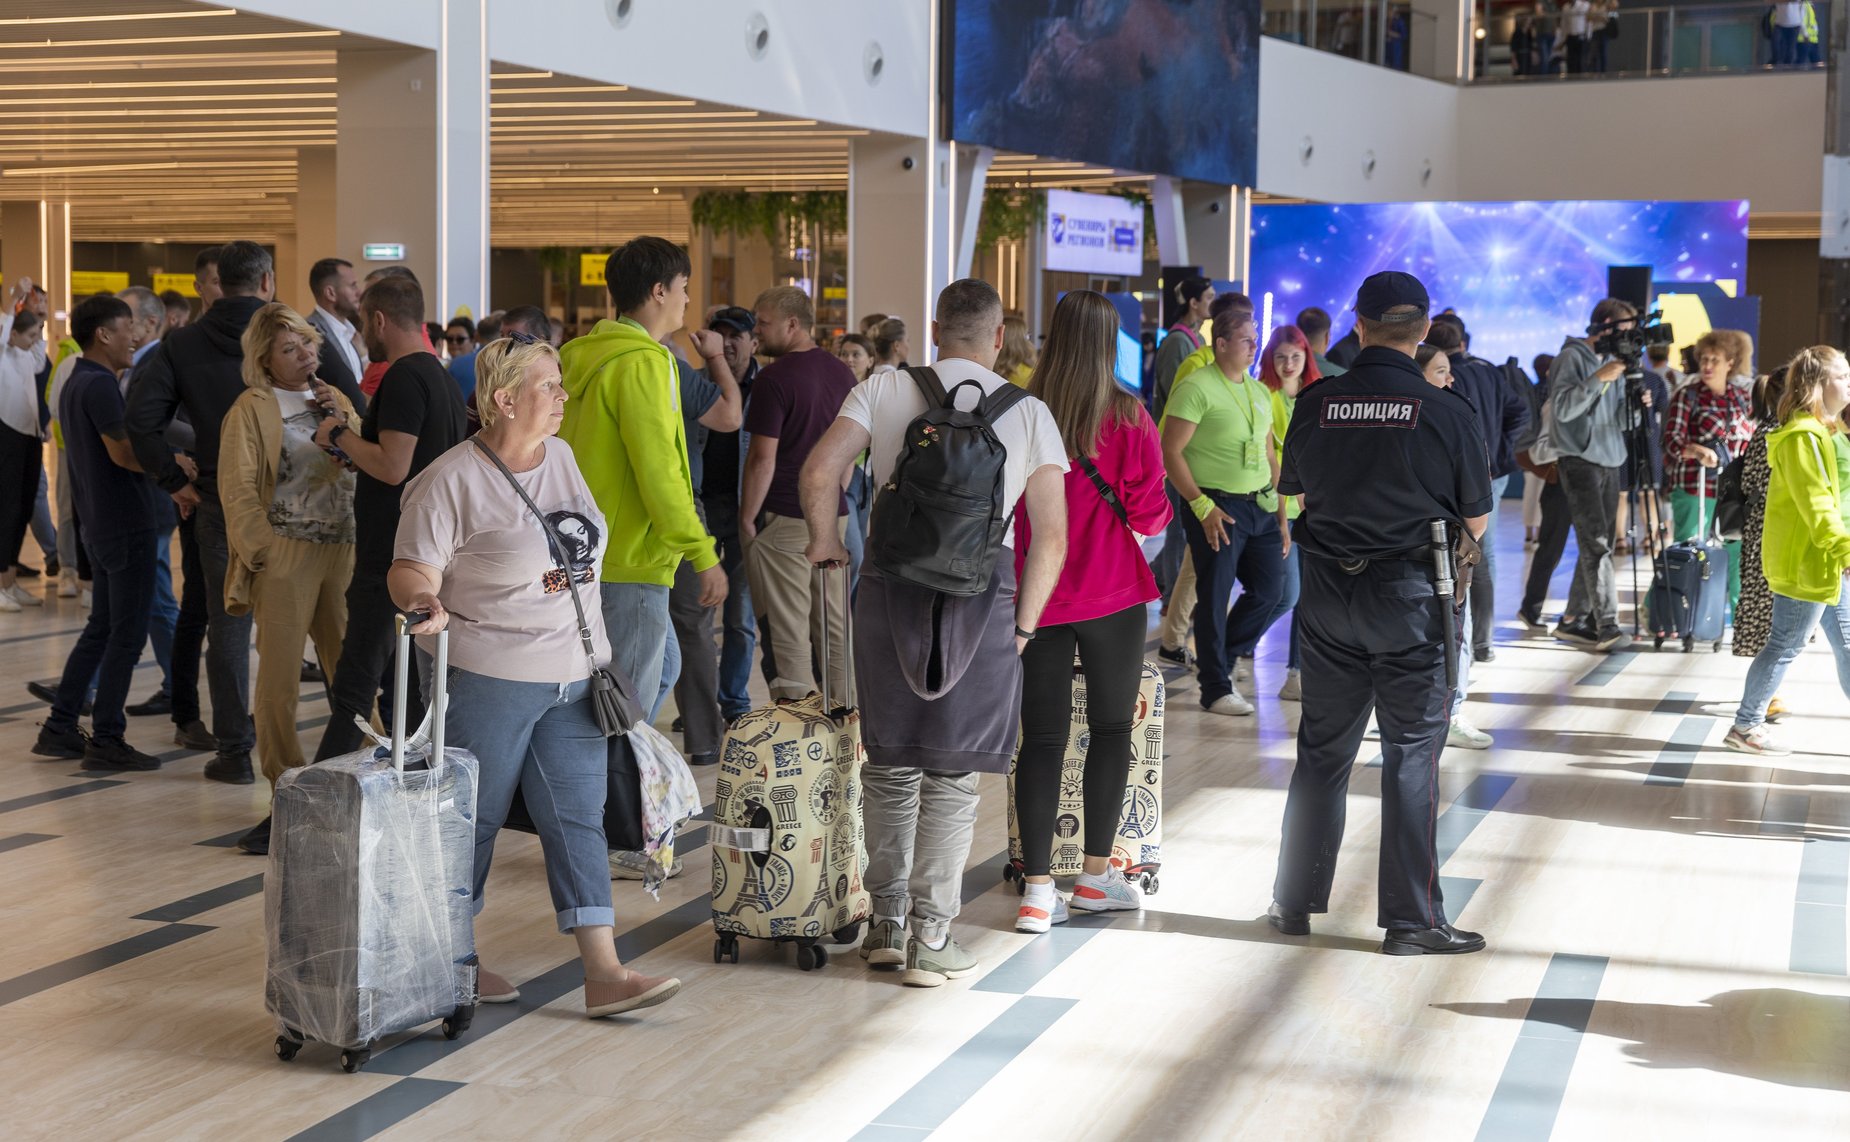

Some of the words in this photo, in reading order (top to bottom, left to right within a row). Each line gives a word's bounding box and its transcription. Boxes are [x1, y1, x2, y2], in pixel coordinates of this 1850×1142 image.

[1067, 218, 1106, 233] СУВЕНИРЫ
[1067, 234, 1104, 248] РЕГИОНОВ
[1327, 403, 1413, 422] ПОЛИЦИЯ
[836, 752, 855, 766] GREECE
[1061, 760, 1077, 770] TATES
[1138, 790, 1155, 809] FRANCE
[775, 822, 802, 831] GREECE
[1142, 814, 1155, 831] PARIS
[769, 858, 788, 878] FRANCE
[1050, 862, 1081, 871] GREEC
[770, 883, 787, 901] PARIS
